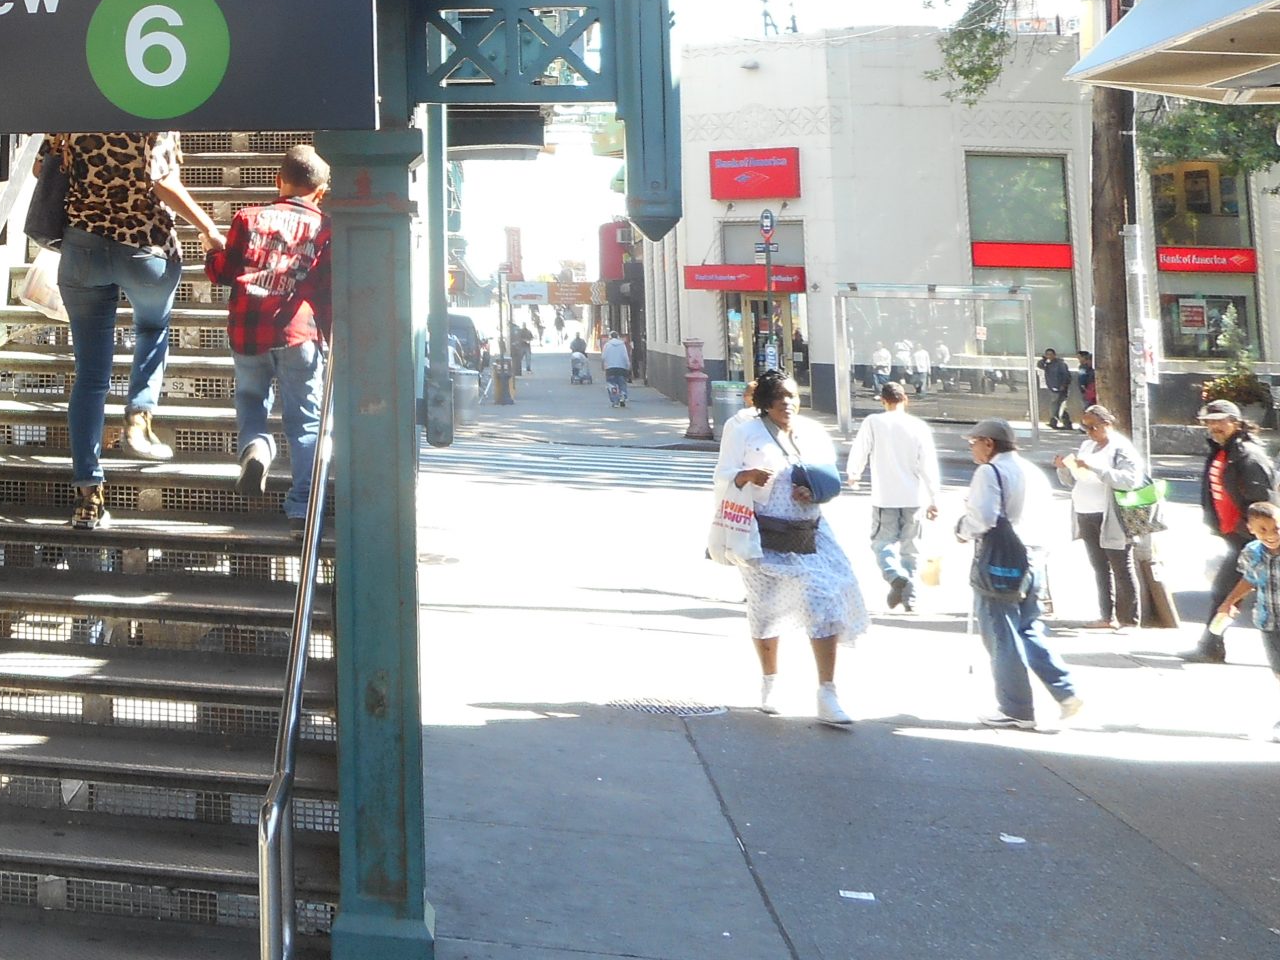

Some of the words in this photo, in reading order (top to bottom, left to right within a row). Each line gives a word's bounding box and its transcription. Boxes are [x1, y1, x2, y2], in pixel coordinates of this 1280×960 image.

[124, 4, 187, 87] 6
[1160, 254, 1181, 263] Bank
[1182, 254, 1191, 264] of
[1192, 255, 1227, 265] America
[172, 381, 184, 390] S2
